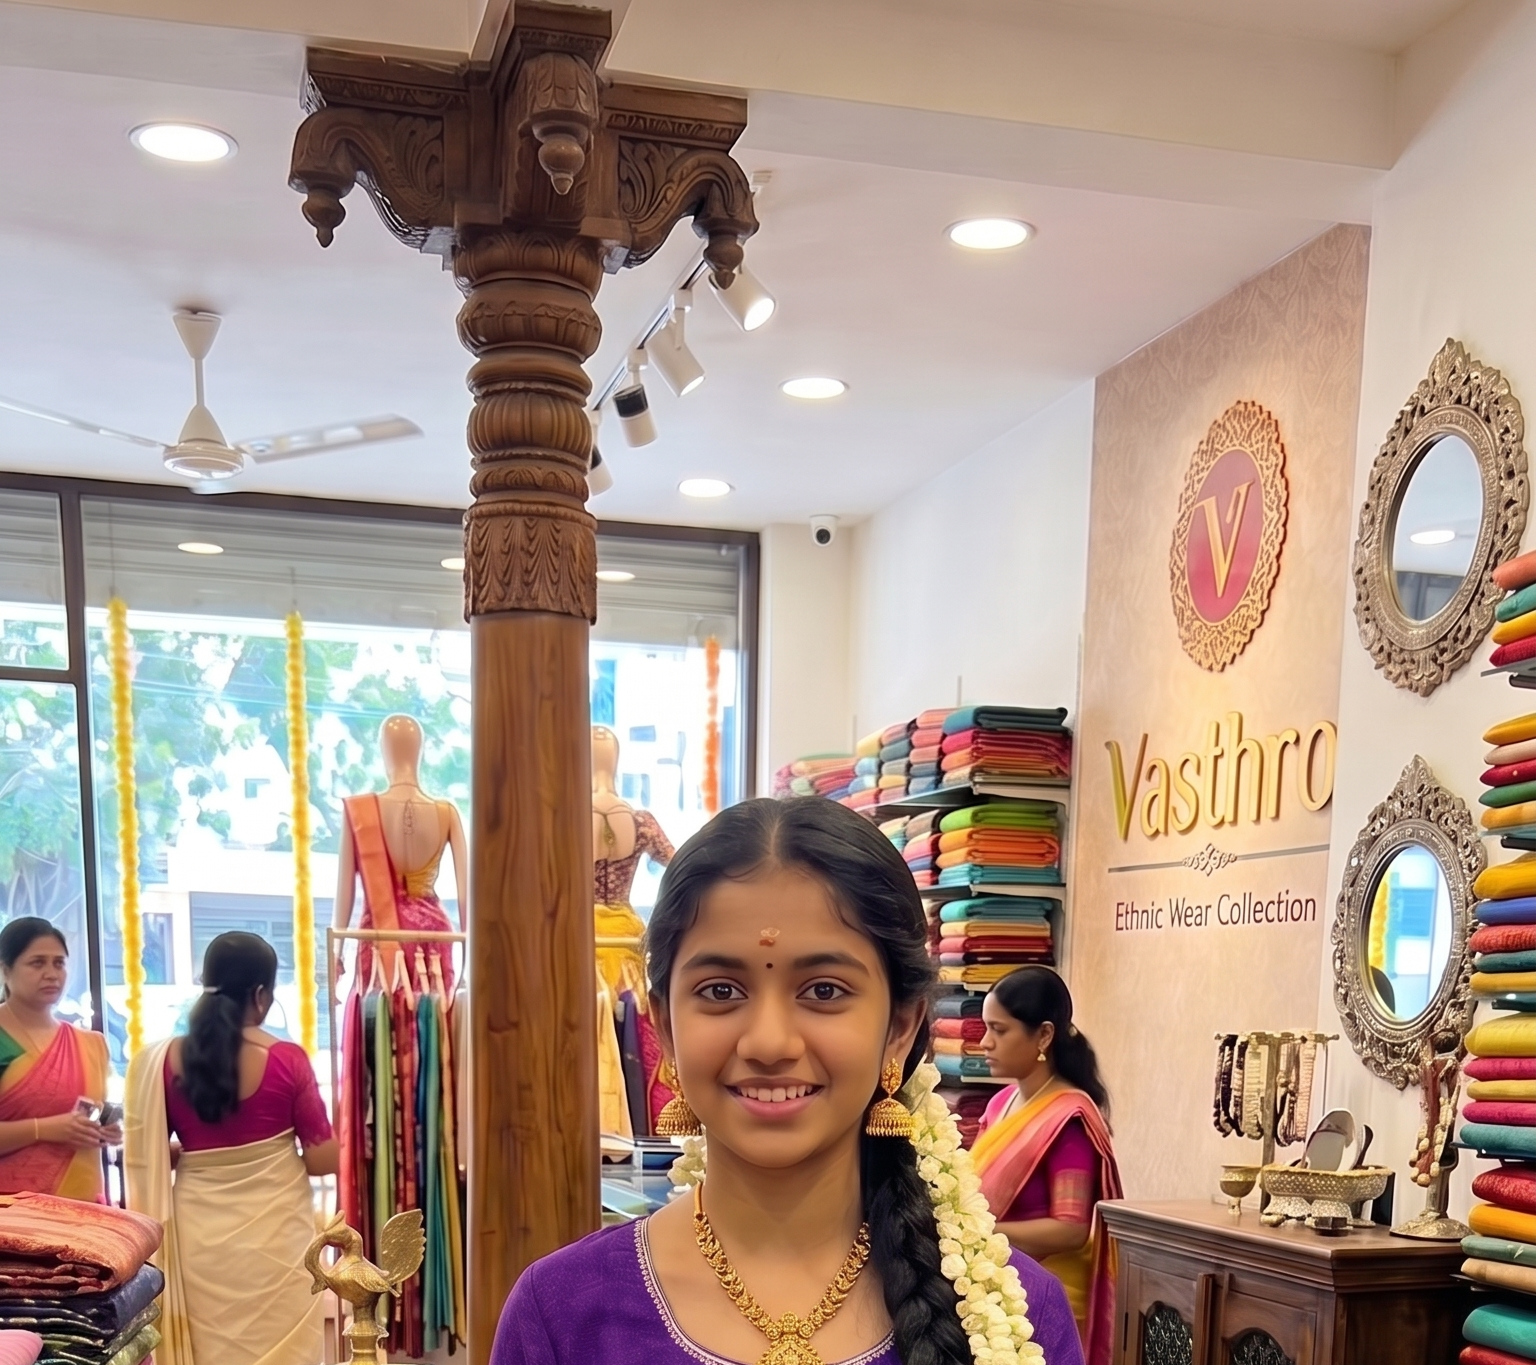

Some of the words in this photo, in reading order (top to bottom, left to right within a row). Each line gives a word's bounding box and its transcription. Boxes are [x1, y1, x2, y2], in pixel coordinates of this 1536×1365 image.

[1104, 711, 1337, 843] Vasthro
[1115, 901, 1164, 931] Ethnic
[1169, 897, 1212, 928] Wear
[1217, 889, 1316, 926] Collection
